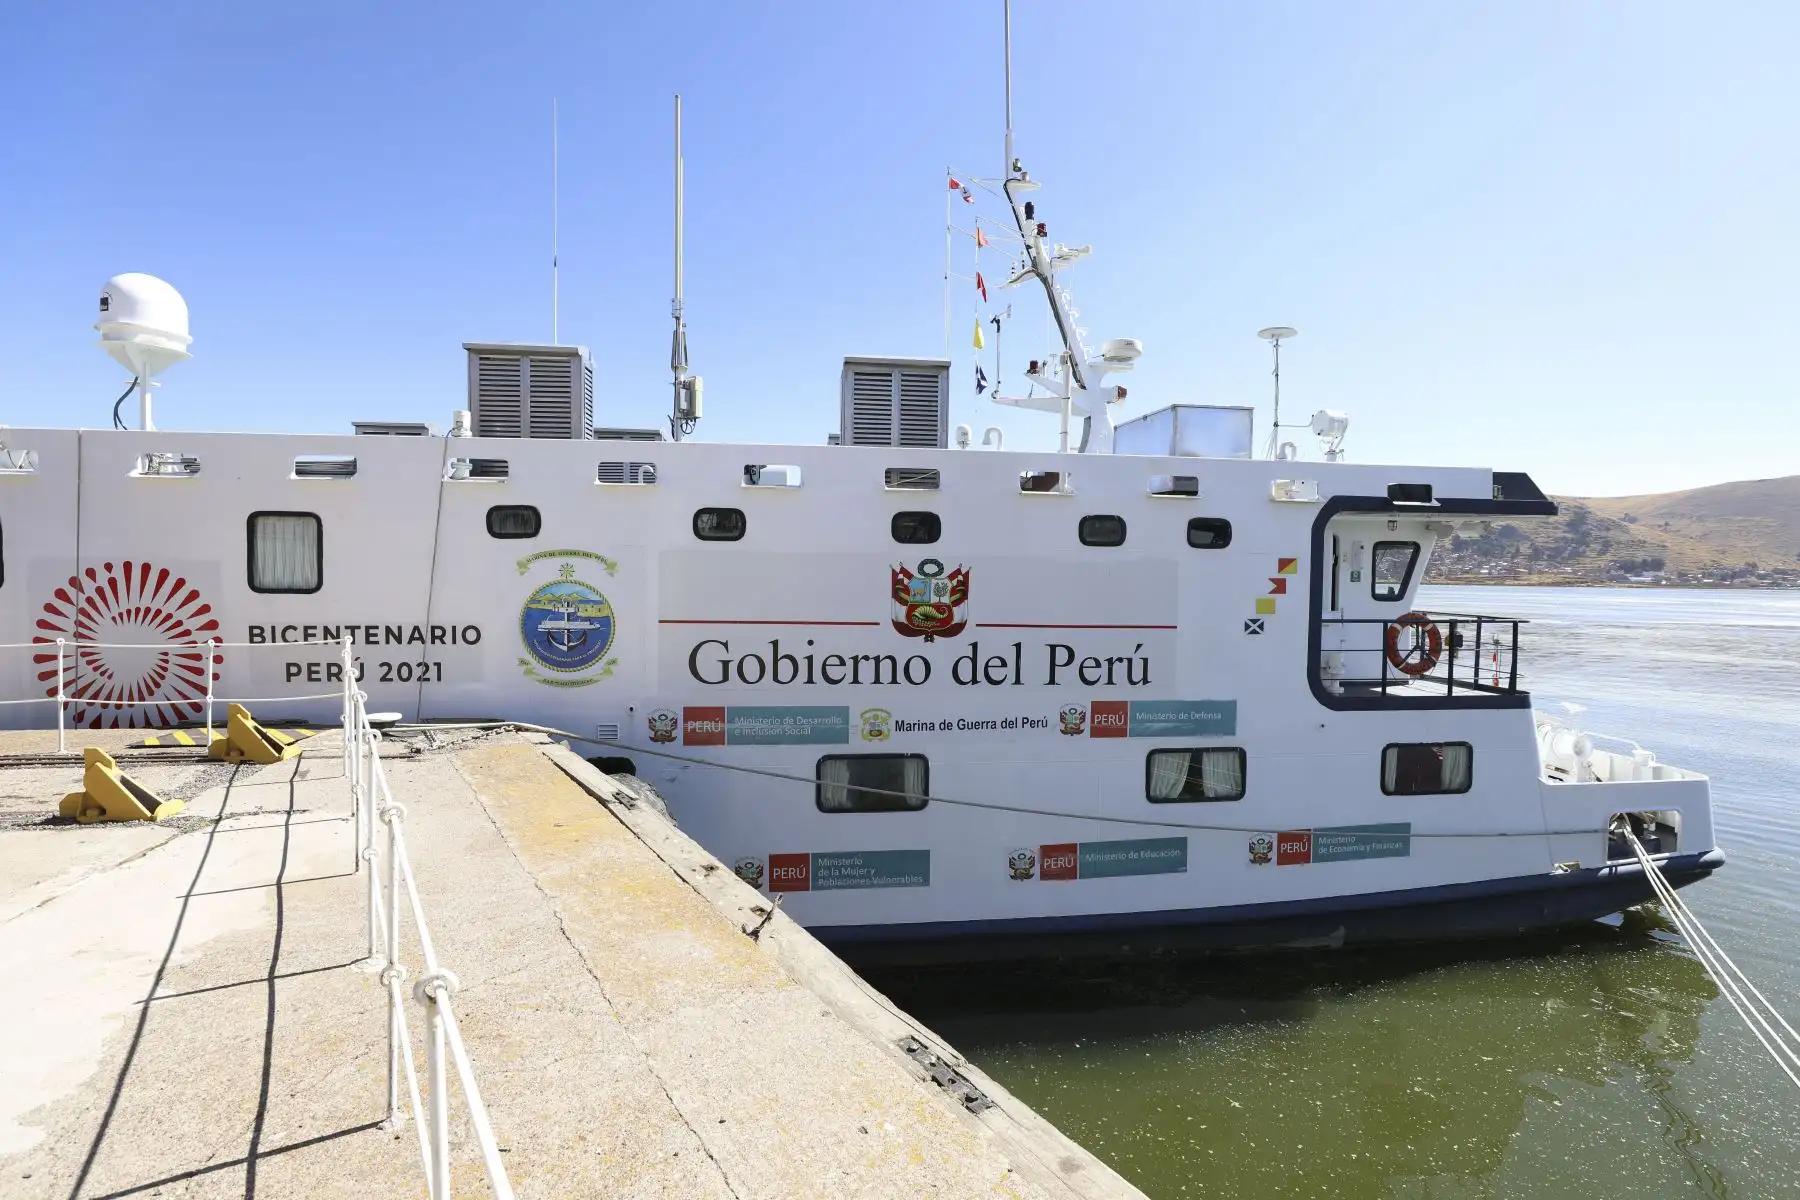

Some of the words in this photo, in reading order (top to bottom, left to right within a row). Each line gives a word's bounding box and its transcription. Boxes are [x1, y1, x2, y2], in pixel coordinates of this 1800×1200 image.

[248, 624, 482, 645] BICENTENARIO
[688, 638, 932, 686] Gobierno
[951, 641, 1024, 686] del
[1043, 642, 1152, 686] Perú
[379, 661, 442, 682] 2021
[734, 716, 780, 725] Ministerio
[782, 716, 794, 725] de
[796, 716, 842, 725] Desarrollo
[1094, 712, 1124, 725] PERÚ
[1136, 711, 1176, 720] Ministerio
[1178, 712, 1188, 720] de
[1190, 711, 1222, 720] Defensa
[688, 717, 720, 732] PERÚ
[895, 720, 935, 732] Marina
[938, 719, 954, 731] de
[956, 718, 997, 730] Guerra
[1000, 717, 1018, 729] del
[1022, 716, 1048, 728] Perú
[742, 727, 782, 736] Inclusión
[786, 726, 810, 735] Social
[1280, 838, 1308, 854] PERÚ
[1318, 836, 1356, 845] Ministerio
[1318, 846, 1328, 854] de
[1330, 844, 1365, 854] Economía
[1372, 842, 1402, 850] Finanzas
[818, 857, 862, 866] Ministerio
[1044, 853, 1074, 868] PERÚ
[1085, 852, 1126, 862] Ministerio
[1140, 848, 1180, 858] Educación
[773, 864, 806, 880] PERÚ
[818, 868, 830, 876] de
[831, 867, 840, 876] la
[842, 866, 868, 877] Mujer
[818, 876, 870, 886] Poblaciones
[872, 874, 923, 884] Vulnerables
